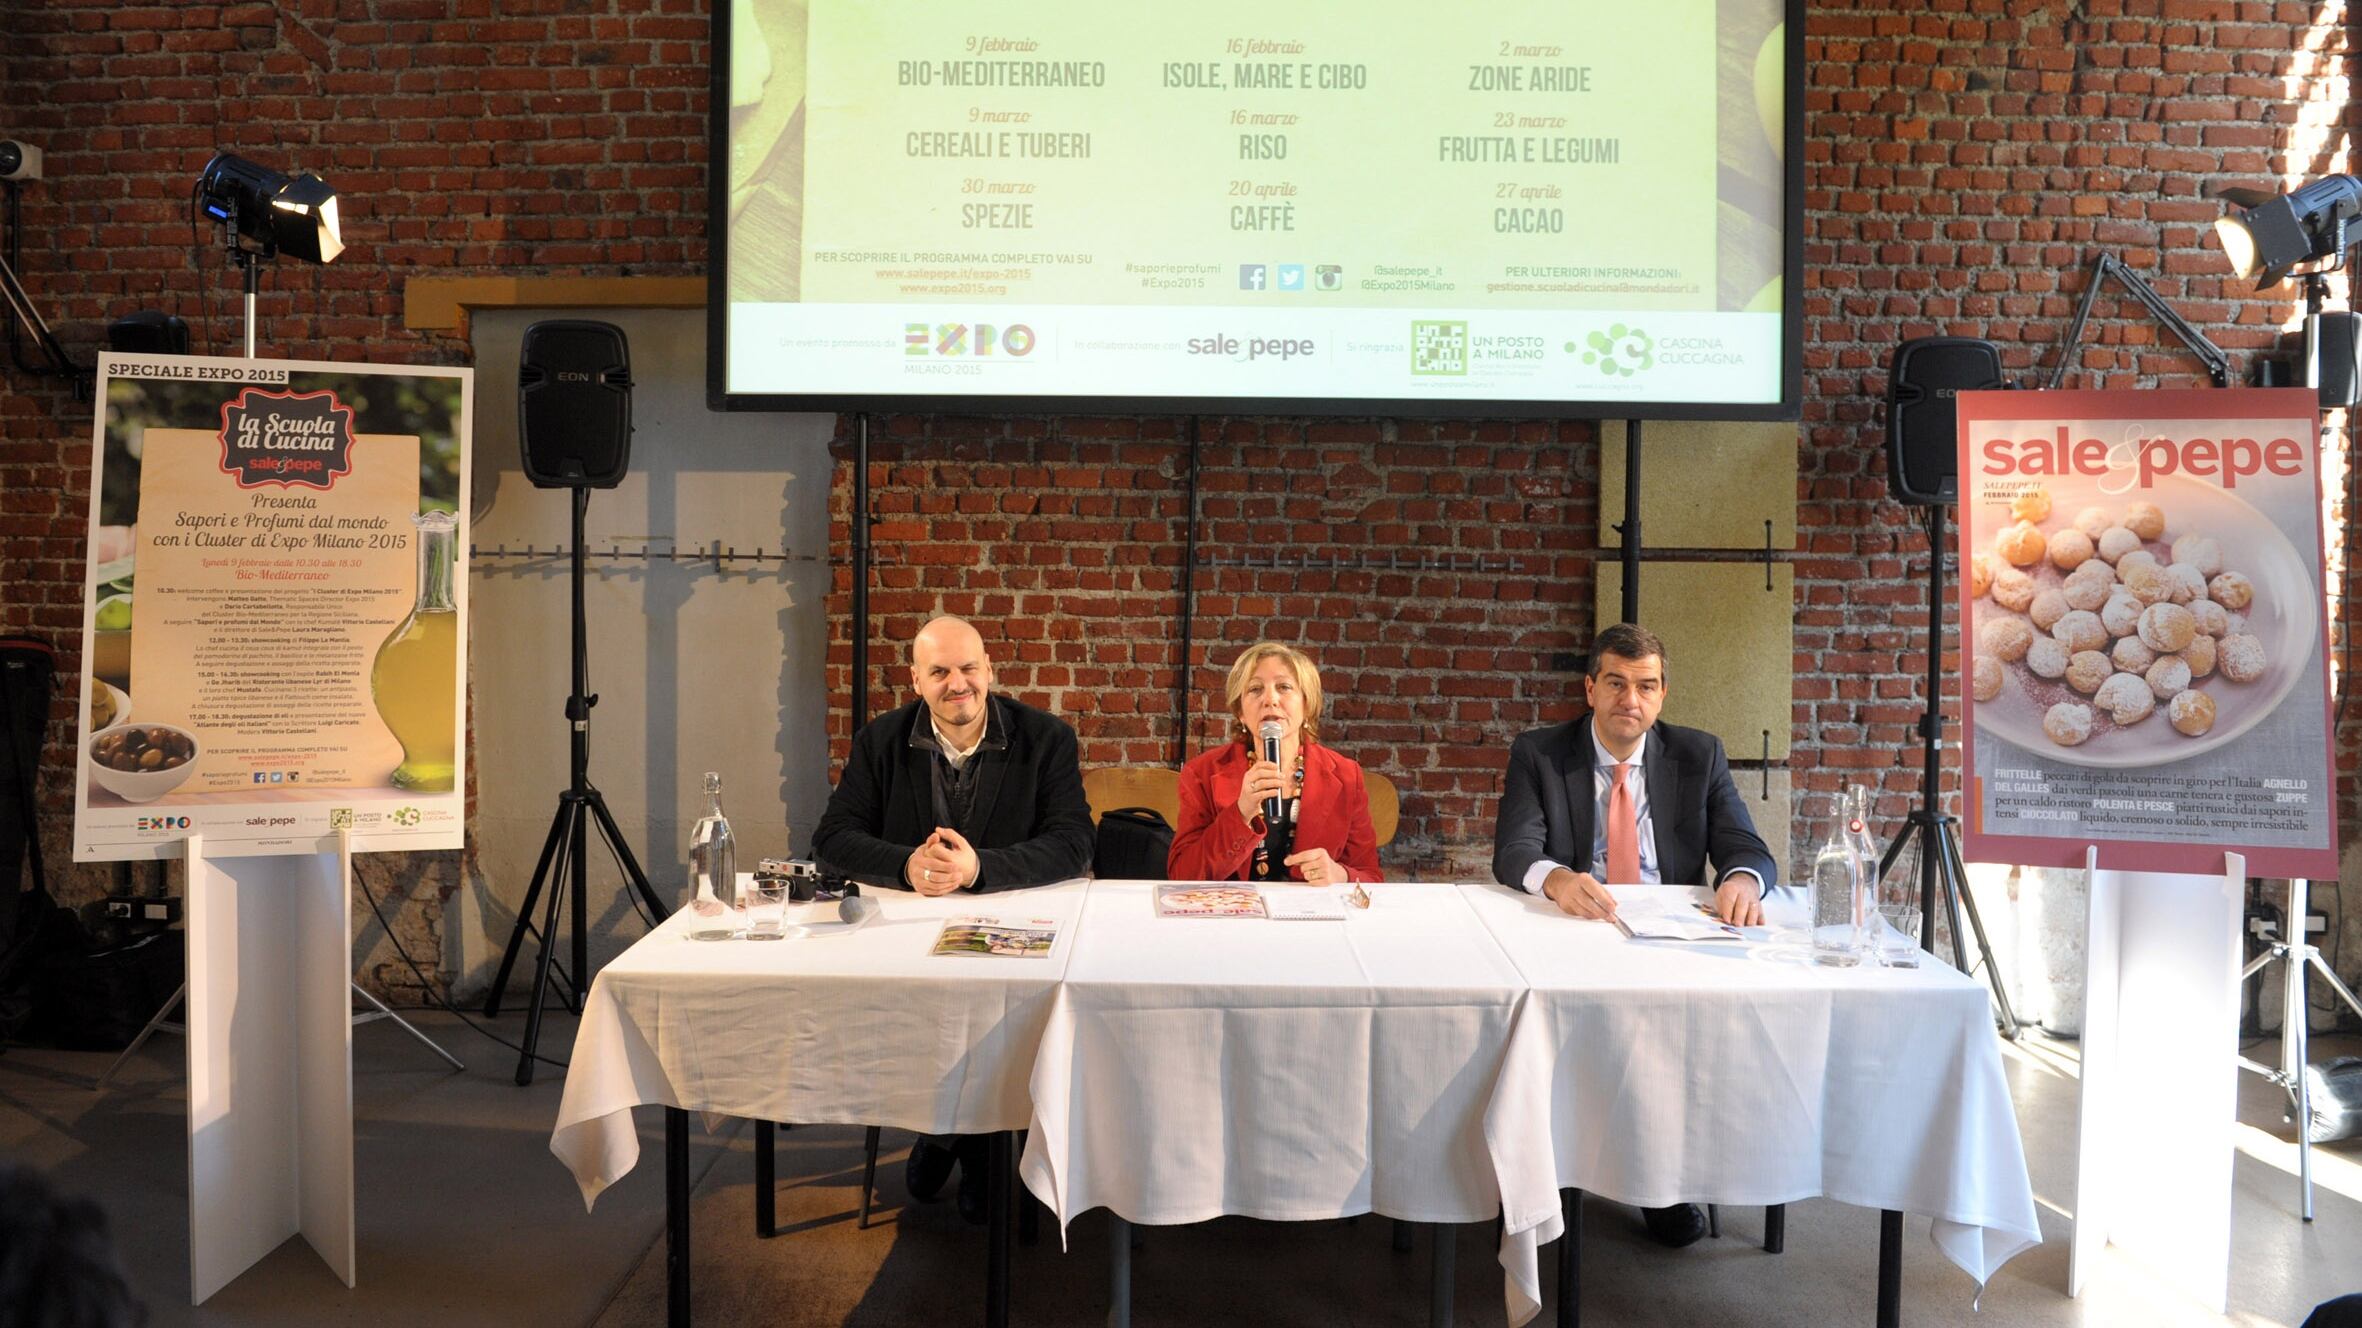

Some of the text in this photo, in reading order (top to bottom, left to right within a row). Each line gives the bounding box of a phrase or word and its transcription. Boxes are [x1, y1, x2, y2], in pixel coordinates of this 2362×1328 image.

[965, 36, 1040, 56] 9 febbraio
[1225, 38, 1306, 58] 16 febbraio
[1499, 41, 1564, 57] 2 marzo
[898, 60, 1106, 87] BIO-MEDITERRANEO
[1163, 62, 1367, 91] ISOLE, MARE E CIBO
[1468, 66, 1592, 92] ZONE ARIDE
[968, 107, 1032, 123] 9 marzo
[1230, 109, 1300, 125] 16 marzo
[1494, 112, 1568, 128] 23 marzo
[906, 131, 1091, 158] CEREALI E TUBERI
[1239, 134, 1288, 160] RISO
[1439, 136, 1620, 163] FRUTTA E LEGUMI
[961, 178, 1036, 194] 30 marzo
[1228, 180, 1298, 201] 20 aprile
[1495, 182, 1562, 202] 27 aprile
[961, 203, 1034, 229] SPEZIE
[1230, 201, 1295, 231] CAFFÈ
[1494, 207, 1564, 233] CACAO
[814, 252, 1093, 265] PER SCOPRIRE IL PROGRAMMA COMPLETO VAI SU
[875, 268, 1032, 281] www.salepepe.it/expo-2015
[1125, 263, 1221, 275] #saporieprofumi
[1374, 265, 1443, 279] @salepepe_it
[1505, 267, 1529, 278] PER
[1531, 267, 1591, 278] ULTERIORI
[899, 283, 1007, 295] www.expo2015.org
[1141, 277, 1205, 289] #Expo2015
[1361, 279, 1455, 292] @Expo2015Milano
[904, 323, 1036, 357] EXPO
[1472, 336, 1545, 348] UN POSTO
[1659, 337, 1724, 350] CASCINA
[1472, 349, 1545, 360] A MILANO
[1659, 352, 1744, 365] CUCCAGNA
[107, 363, 286, 382] SPECIALE EXPO 2015
[557, 372, 589, 382] EON
[904, 364, 983, 375] MILANO 2015
[1936, 388, 1956, 399] EO
[238, 412, 336, 436] la Scuola
[237, 430, 335, 451] di Cucina
[1982, 423, 2304, 496] sale&pepe
[251, 493, 318, 509] Presenta
[175, 511, 390, 532] Sapori e Profumi dal mondo
[153, 531, 407, 552] con i Cluster di Expo Milano 2015
[230, 558, 238, 567] 9
[237, 558, 273, 569] febbraio
[273, 559, 293, 567] dalle
[321, 559, 336, 568] alle
[234, 569, 330, 581] Bio-Mediterraneo
[1994, 768, 2042, 780] FRITTELLE
[2042, 771, 2080, 784] peccati
[2080, 771, 2092, 783] di
[2092, 772, 2115, 785] gola
[2115, 772, 2129, 784] da
[2130, 773, 2171, 788] scoprire
[2173, 774, 2185, 786] in
[2185, 776, 2208, 789] giro
[2208, 778, 2226, 791] per
[2262, 778, 2308, 790] AGNELLO
[1994, 781, 2308, 805] DEL GALLES dai verdi pascoli una carne tenera e gustosa ZUPPE
[1995, 796, 2309, 819] per un caldo ristoro POLENTA E PESCE piatti rustici dai sapori in-
[137, 815, 192, 831] EXPO
[1995, 808, 2309, 832] tensi CIOCCOLATO liquido, cremoso o solido, sempre irresistibile
